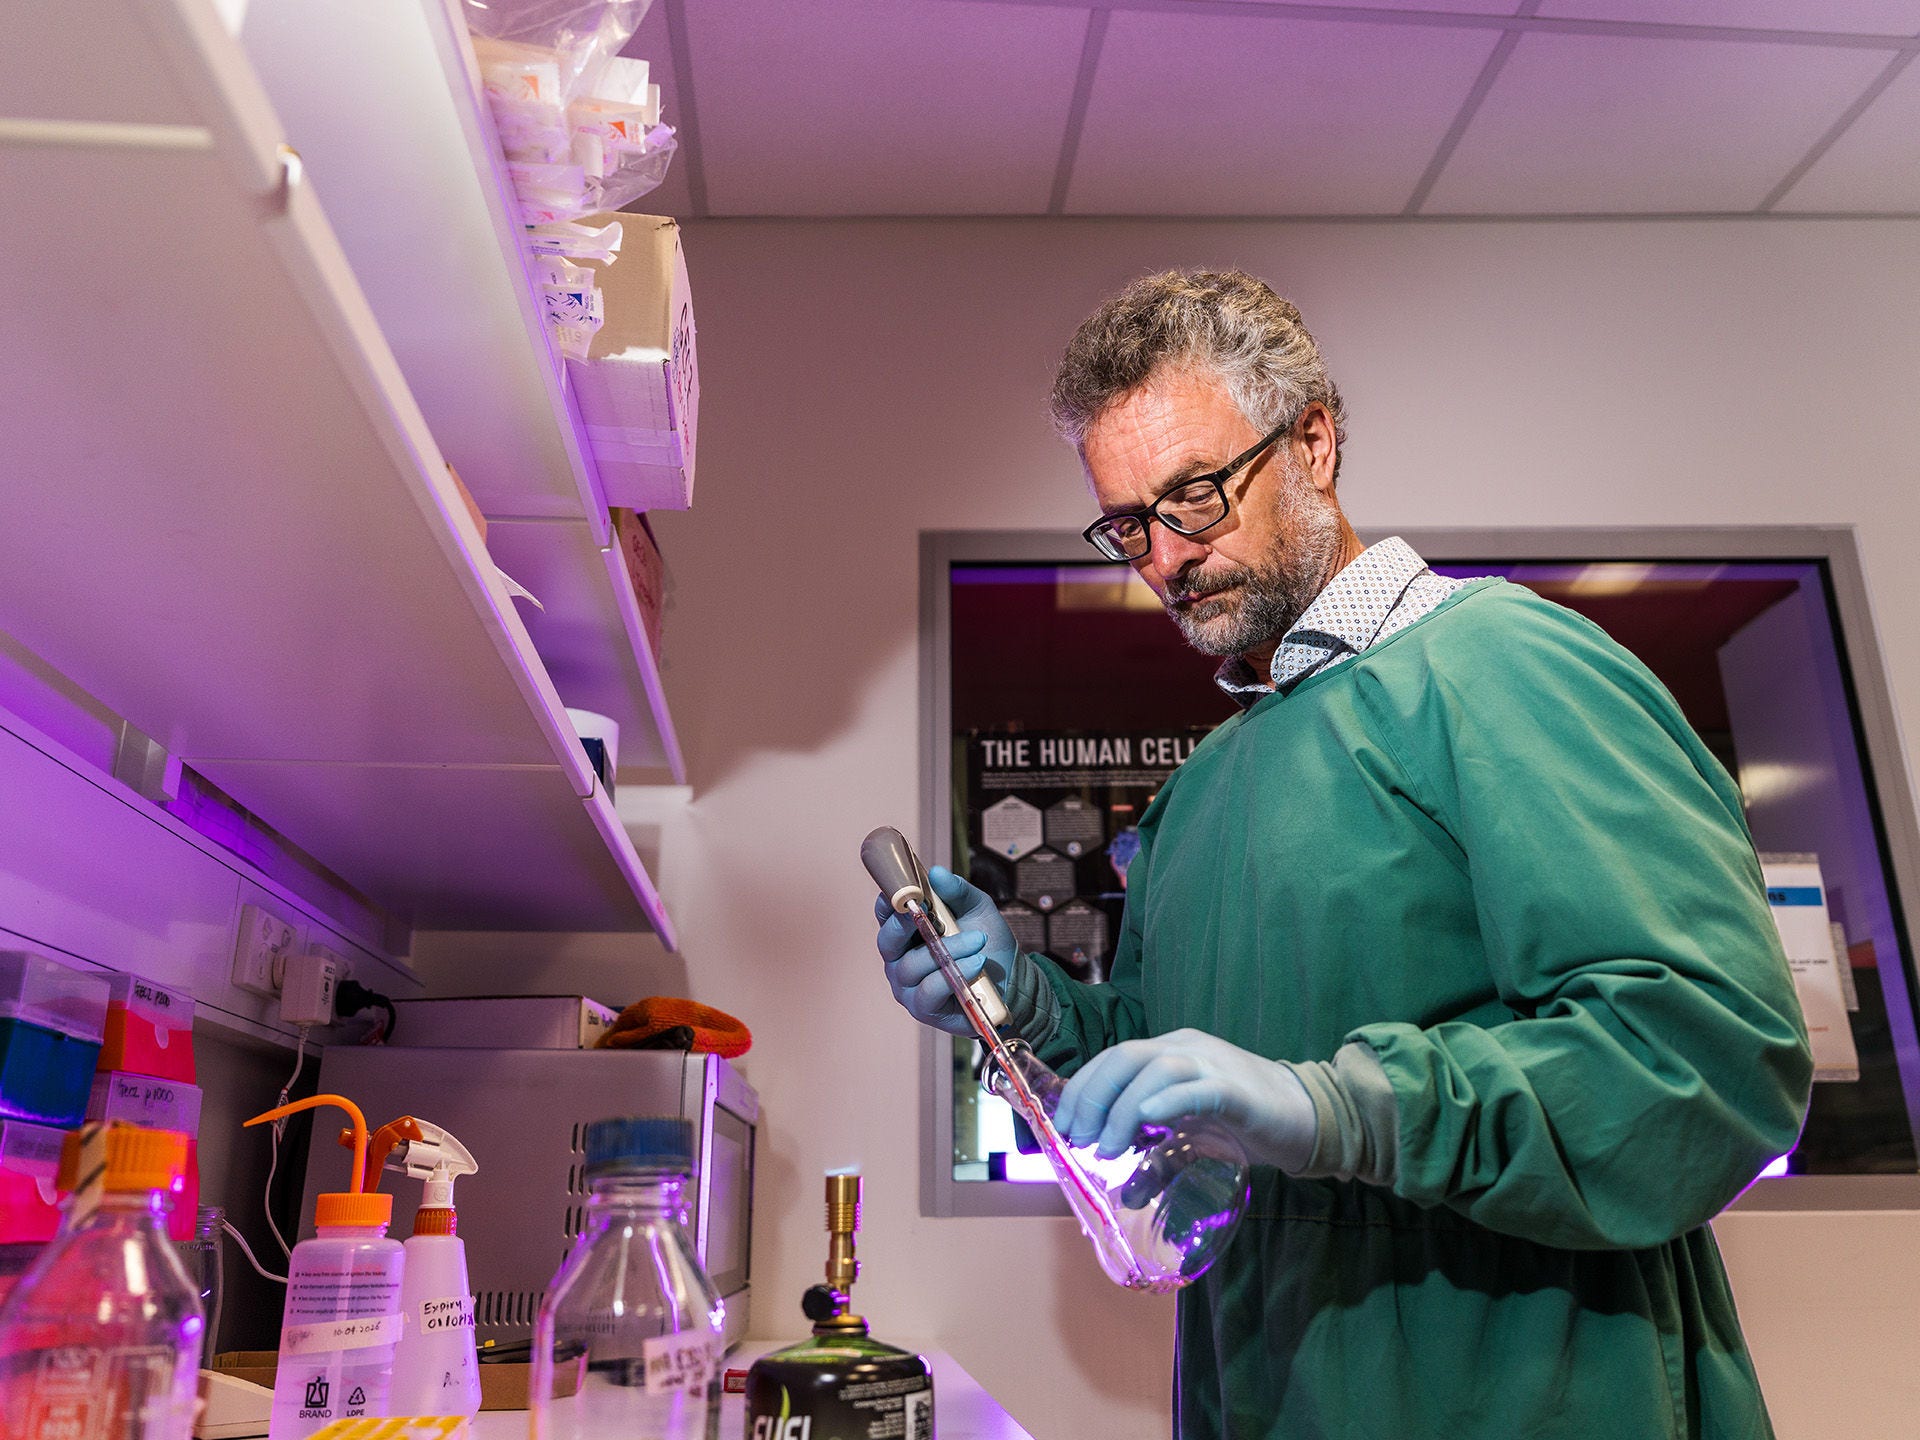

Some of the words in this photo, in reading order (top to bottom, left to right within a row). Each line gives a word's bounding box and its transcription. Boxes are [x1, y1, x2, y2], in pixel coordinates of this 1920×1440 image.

[982, 740, 1031, 767] THE
[1039, 738, 1131, 766] HUMAN
[299, 1409, 332, 1418] BRAND
[346, 1408, 365, 1417] LDPE
